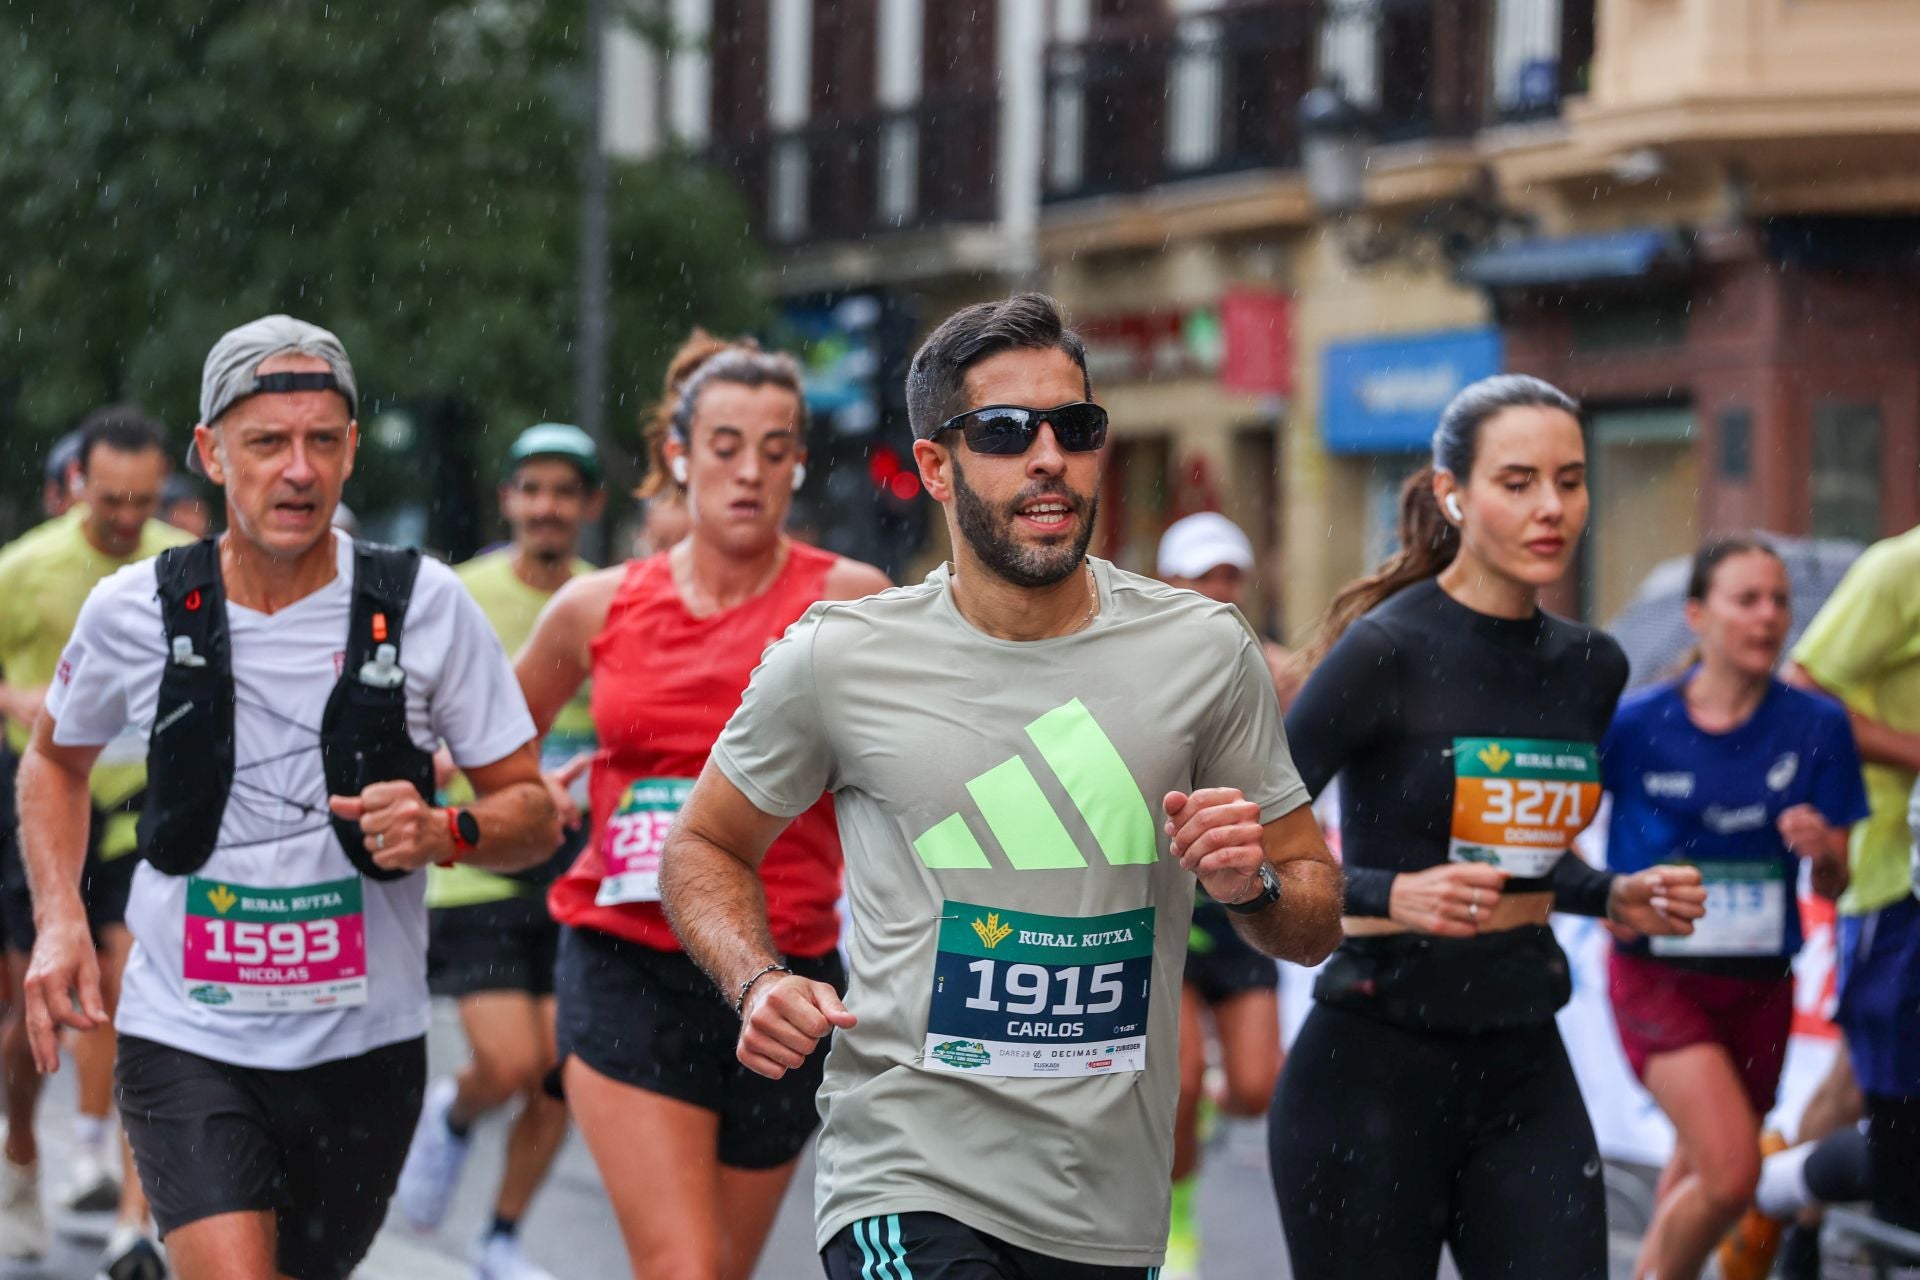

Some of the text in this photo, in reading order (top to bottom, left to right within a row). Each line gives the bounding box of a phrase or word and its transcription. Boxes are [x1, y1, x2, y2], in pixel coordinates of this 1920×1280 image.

[1481, 779, 1582, 826] 3271
[241, 892, 343, 912] RURAL KUTXA
[205, 919, 340, 966] 1593
[1018, 928, 1134, 948] RURAL KUTXA
[239, 966, 310, 983] NICOLAS
[965, 959, 1124, 1016] 1915
[1006, 1021, 1084, 1038] CARLOS
[1051, 1048, 1098, 1058] DECIMAS
[1115, 1043, 1141, 1052] ZUBIEDER
